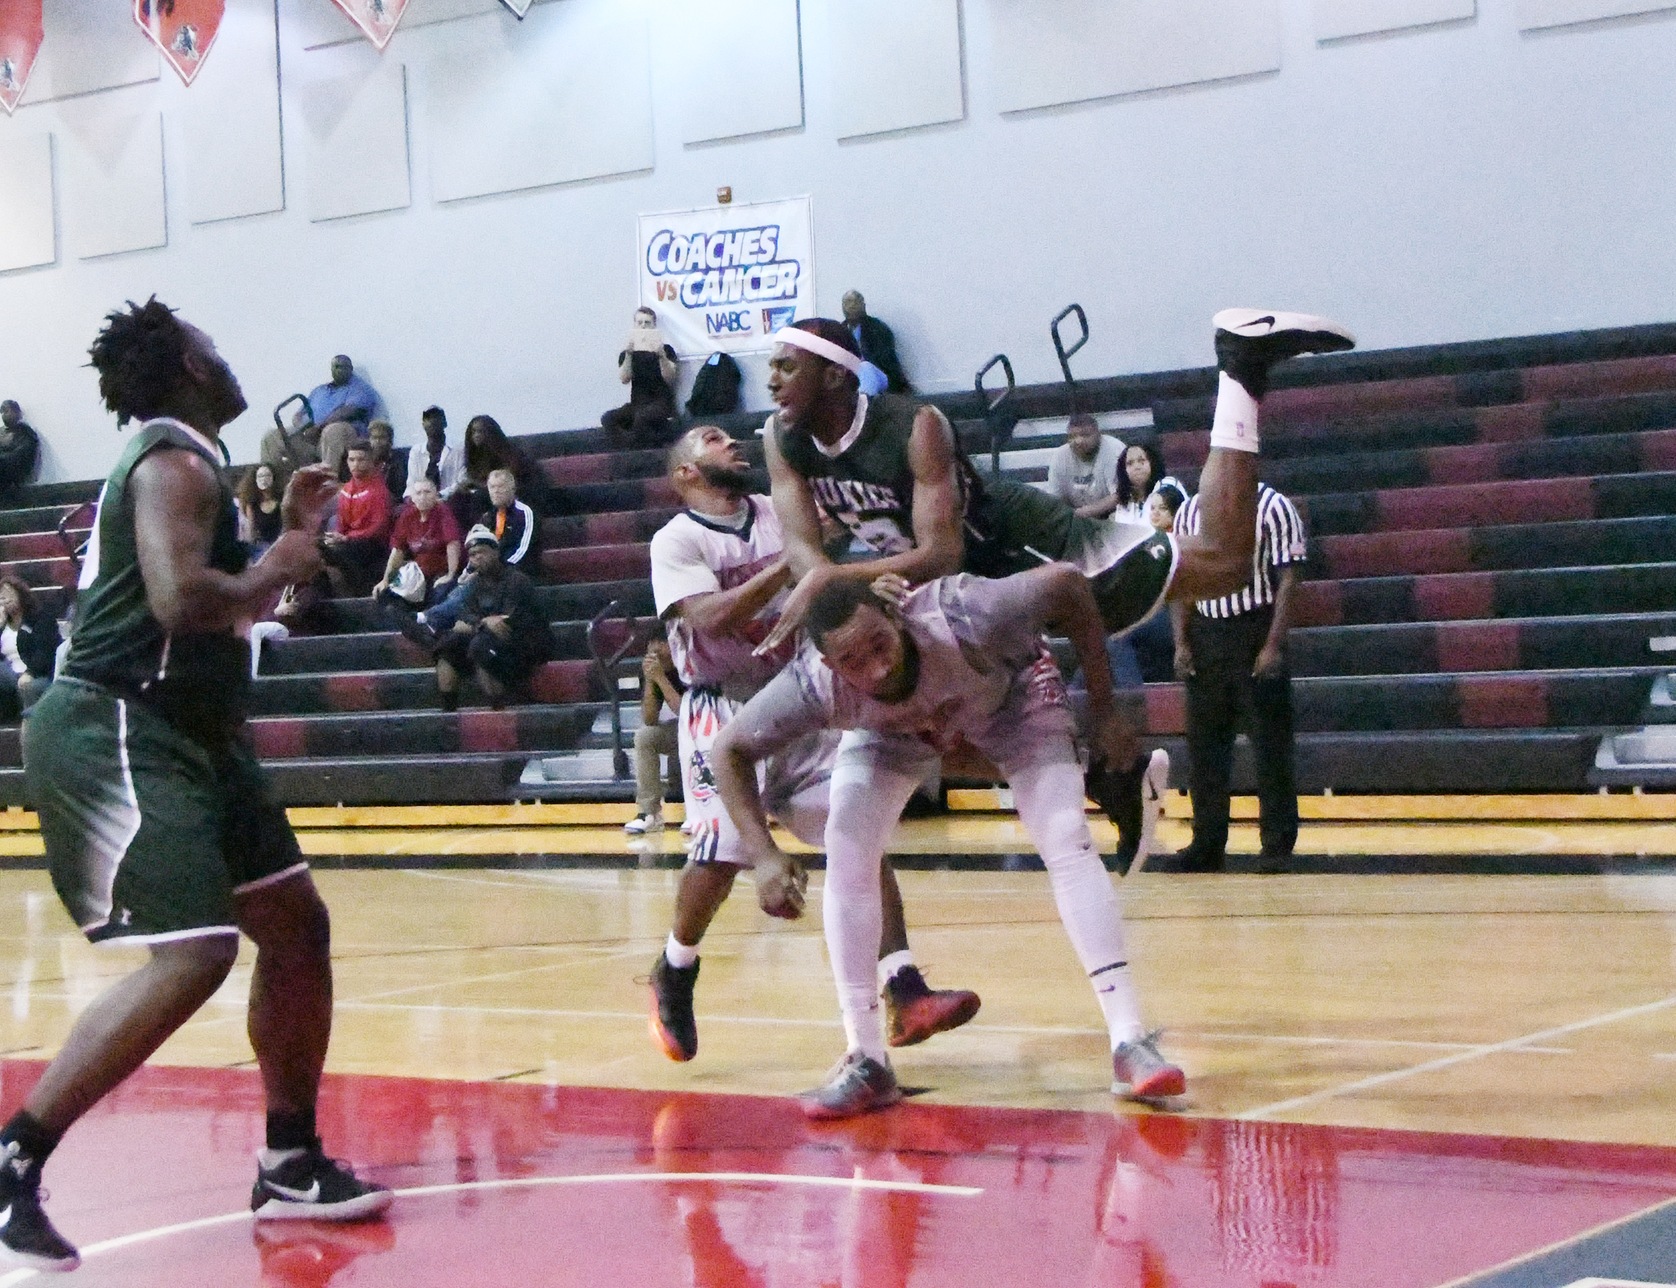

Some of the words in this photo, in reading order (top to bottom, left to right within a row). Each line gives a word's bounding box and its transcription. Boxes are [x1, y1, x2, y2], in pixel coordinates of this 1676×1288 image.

[648, 225, 779, 276] COACHES
[656, 280, 677, 301] VS
[681, 259, 800, 308] CANCER
[706, 310, 751, 334] NABC
